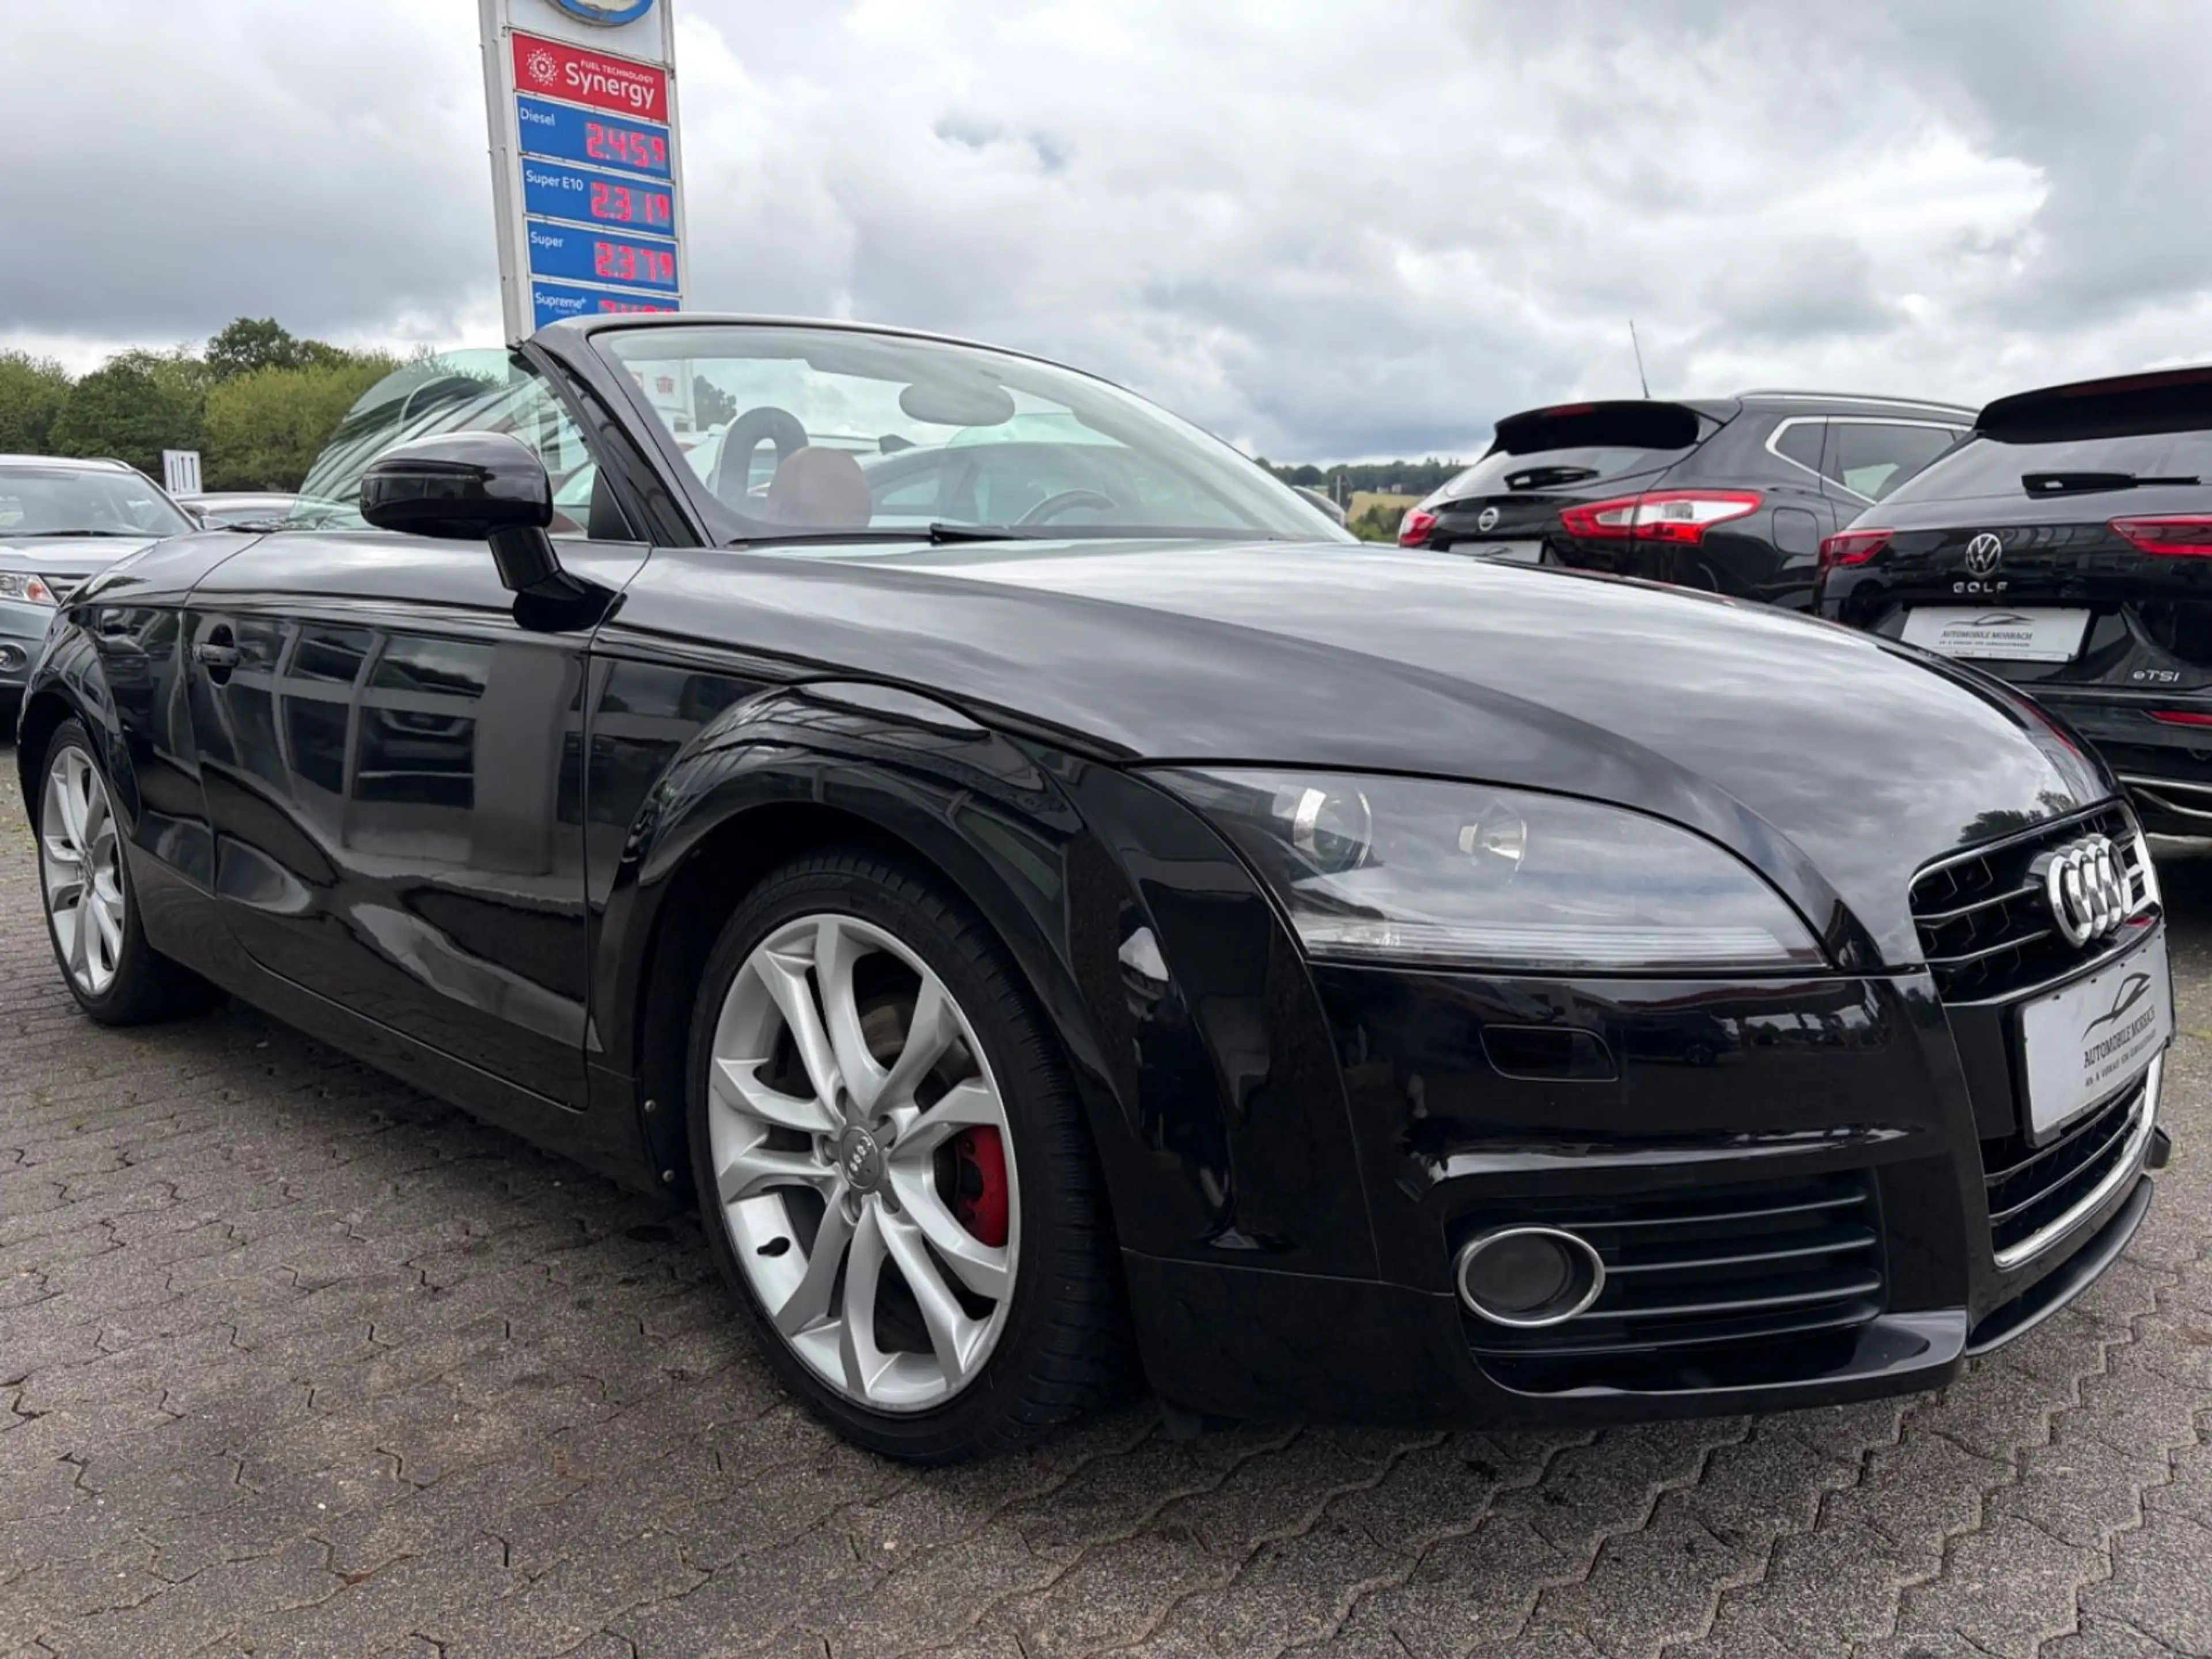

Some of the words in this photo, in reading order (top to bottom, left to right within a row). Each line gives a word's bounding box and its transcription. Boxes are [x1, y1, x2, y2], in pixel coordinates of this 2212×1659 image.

[580, 59, 600, 71] FUEL
[602, 65, 654, 84] TECHNOLOGY
[565, 62, 655, 109] Synergy
[520, 107, 555, 126] Diesel
[526, 170, 559, 188] Super
[562, 176, 584, 191] E10
[530, 230, 564, 248] Super
[1953, 581, 2009, 594] GOLF
[2084, 1025, 2131, 1069] AUTOMOBILE
